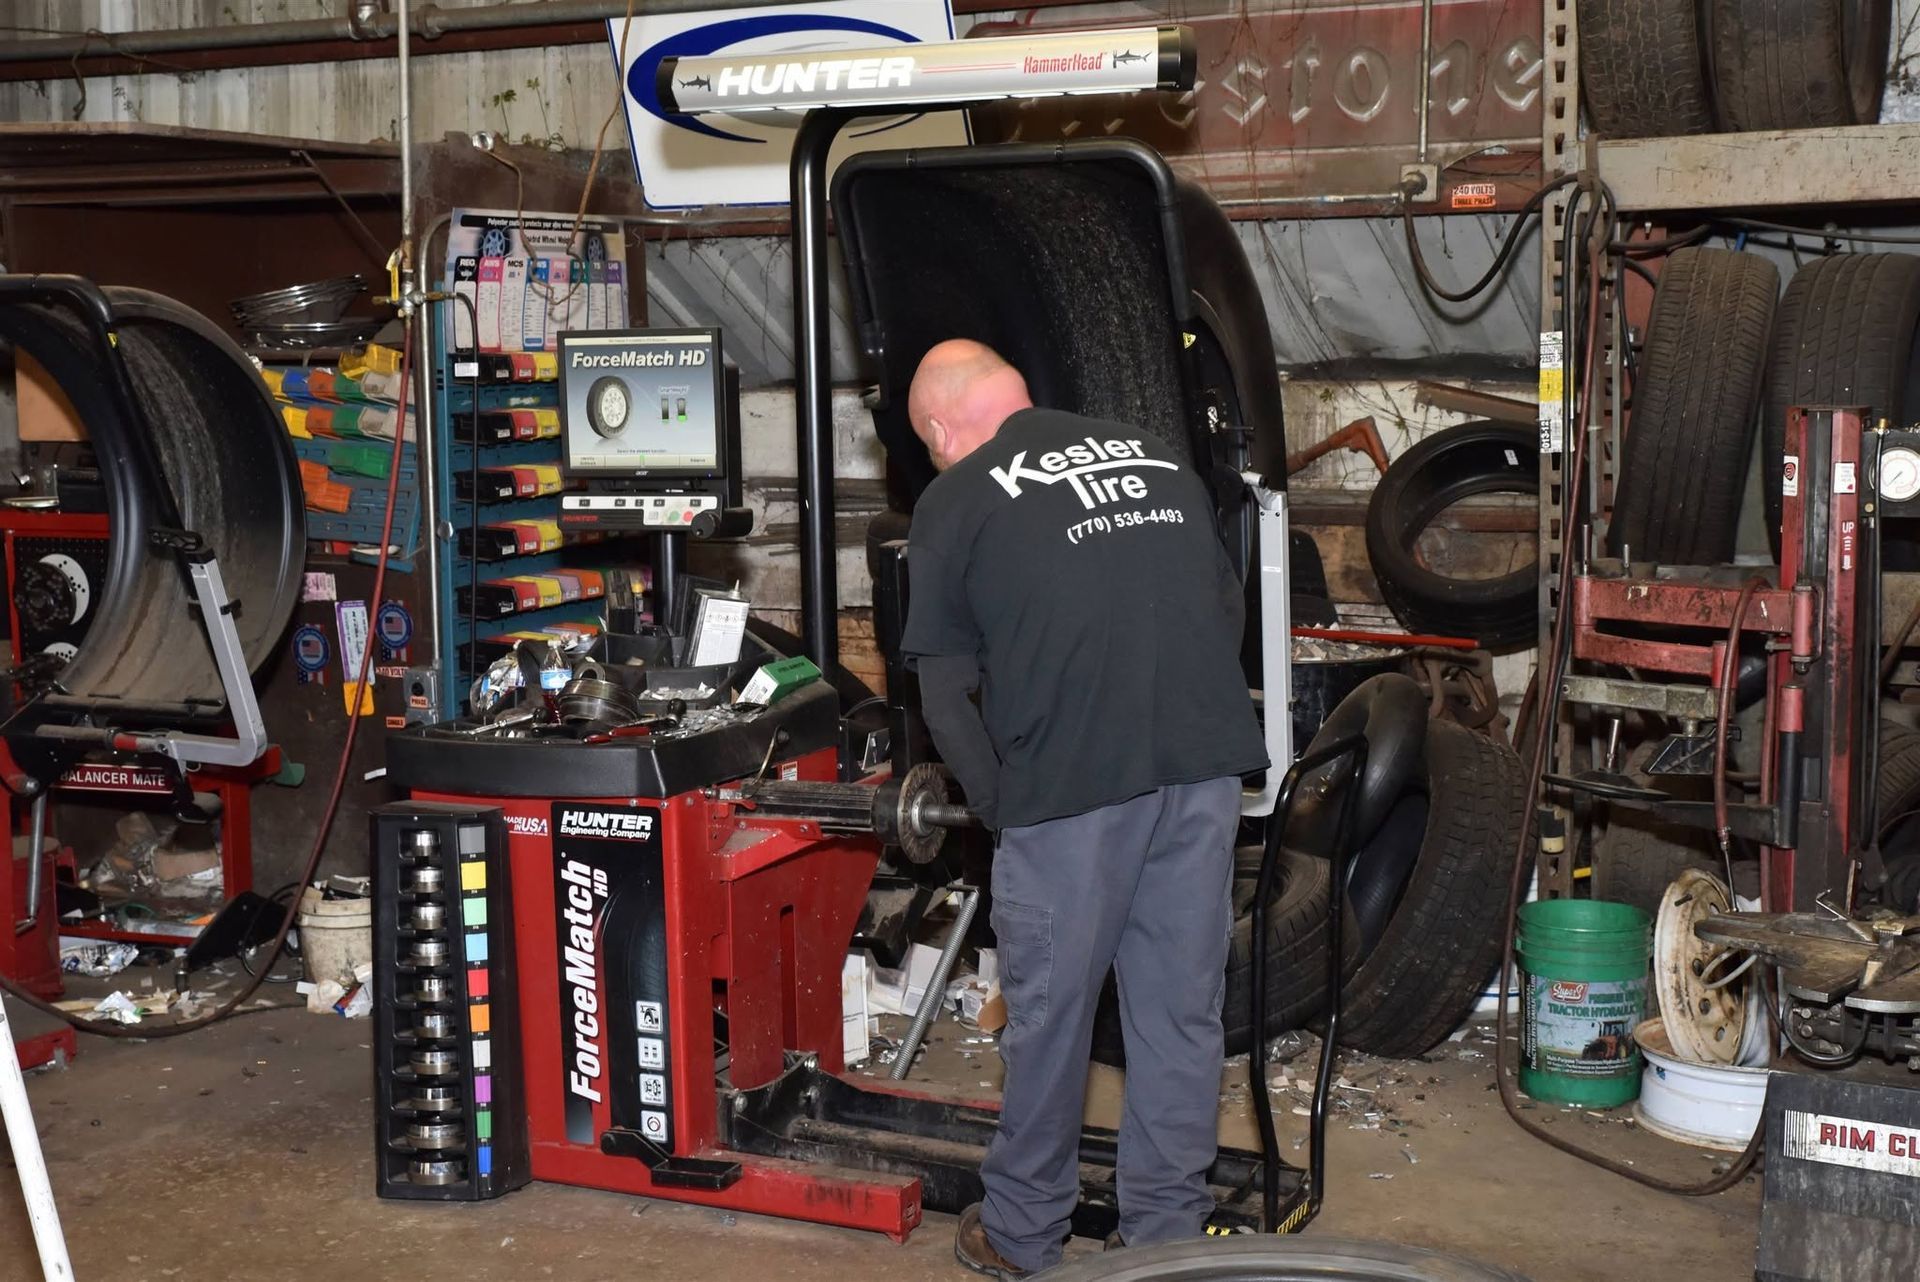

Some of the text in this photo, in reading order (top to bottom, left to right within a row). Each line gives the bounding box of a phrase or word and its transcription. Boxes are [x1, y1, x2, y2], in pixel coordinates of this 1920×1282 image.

[1023, 52, 1103, 74] HammerHead
[717, 57, 915, 97] HUNTER
[1470, 184, 1494, 195] VOLTS
[507, 260, 523, 268] MCS
[571, 349, 706, 369] ForceMatch HD
[988, 436, 1147, 500] Kesler
[1062, 468, 1149, 510] Tire
[1066, 508, 1185, 545] (770) 536-4493
[1842, 521, 1855, 534] UP
[132, 773, 166, 786] MATE
[521, 817, 549, 834] USA
[561, 810, 653, 832] HUNTER
[560, 825, 652, 841] Engineering Company
[593, 868, 609, 899] HD
[561, 858, 602, 1104] ForceMatch
[1547, 1002, 1590, 1018] TRACTOR
[1820, 1123, 1875, 1152] RIM
